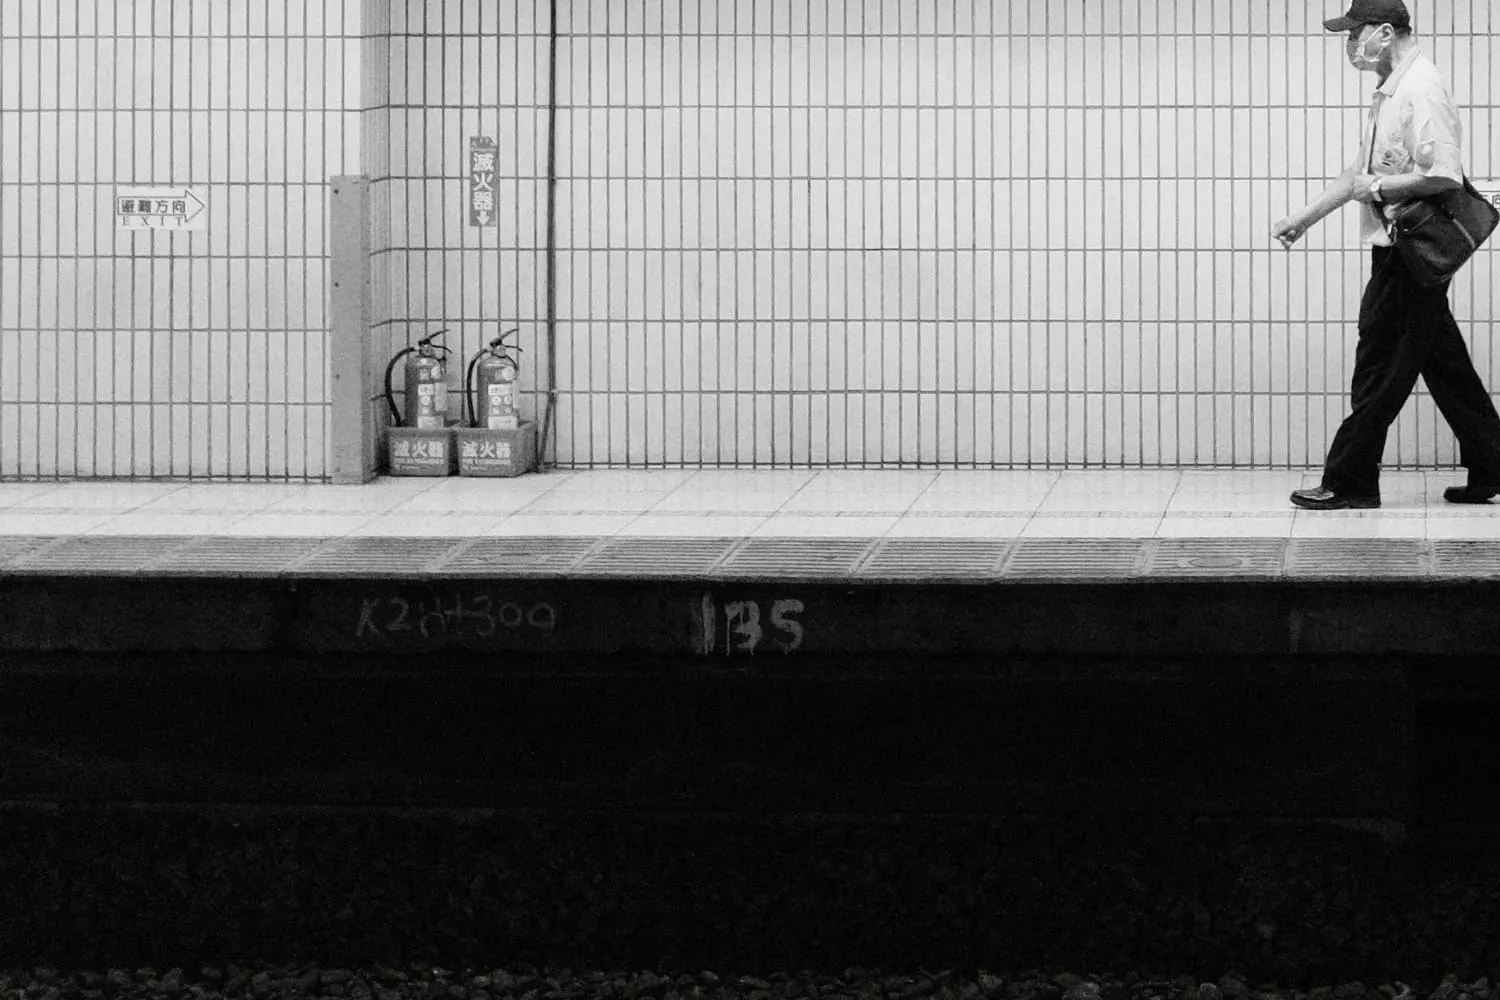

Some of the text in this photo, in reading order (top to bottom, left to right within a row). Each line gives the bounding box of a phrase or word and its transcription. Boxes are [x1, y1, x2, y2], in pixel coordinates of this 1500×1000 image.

[472, 152, 494, 210] 滅火器
[121, 199, 186, 214] 避難方向
[122, 216, 184, 226] EXIT
[394, 440, 444, 457] 滅火器
[462, 441, 511, 458] 滅火器
